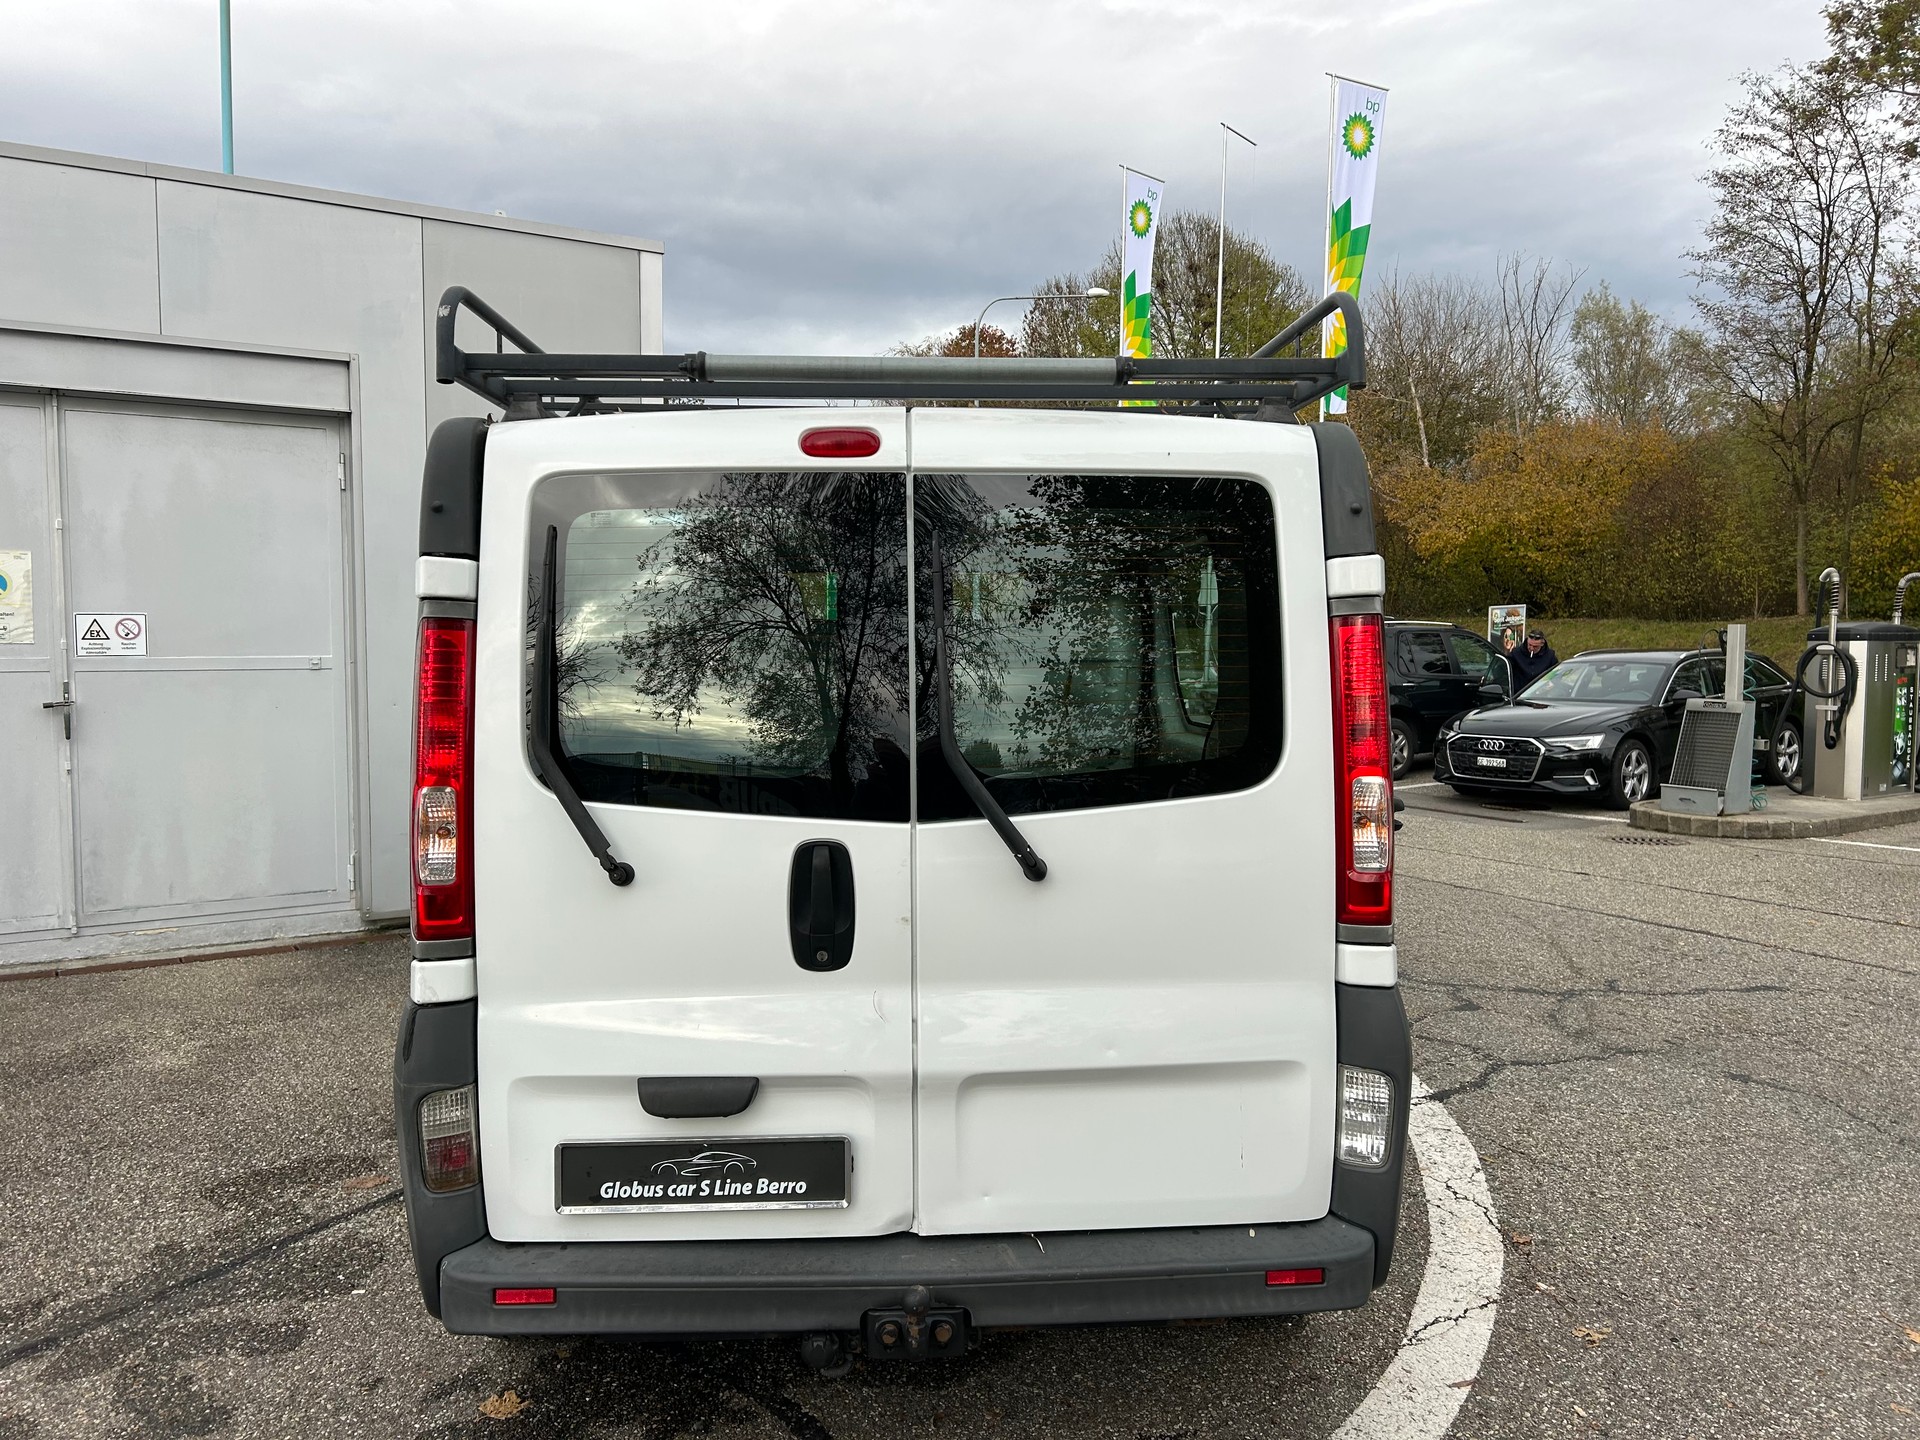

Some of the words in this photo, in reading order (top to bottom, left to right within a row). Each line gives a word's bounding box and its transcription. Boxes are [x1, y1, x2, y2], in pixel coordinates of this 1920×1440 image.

[1366, 97, 1380, 114] bp
[1147, 187, 1158, 202] bp
[90, 629, 101, 637] EX
[1906, 686, 1914, 769] STAUBSAUGER
[600, 1181, 664, 1199] Globus
[667, 1183, 697, 1197] car
[699, 1180, 711, 1196] S
[714, 1179, 751, 1196] Line
[756, 1178, 807, 1195] Berro
